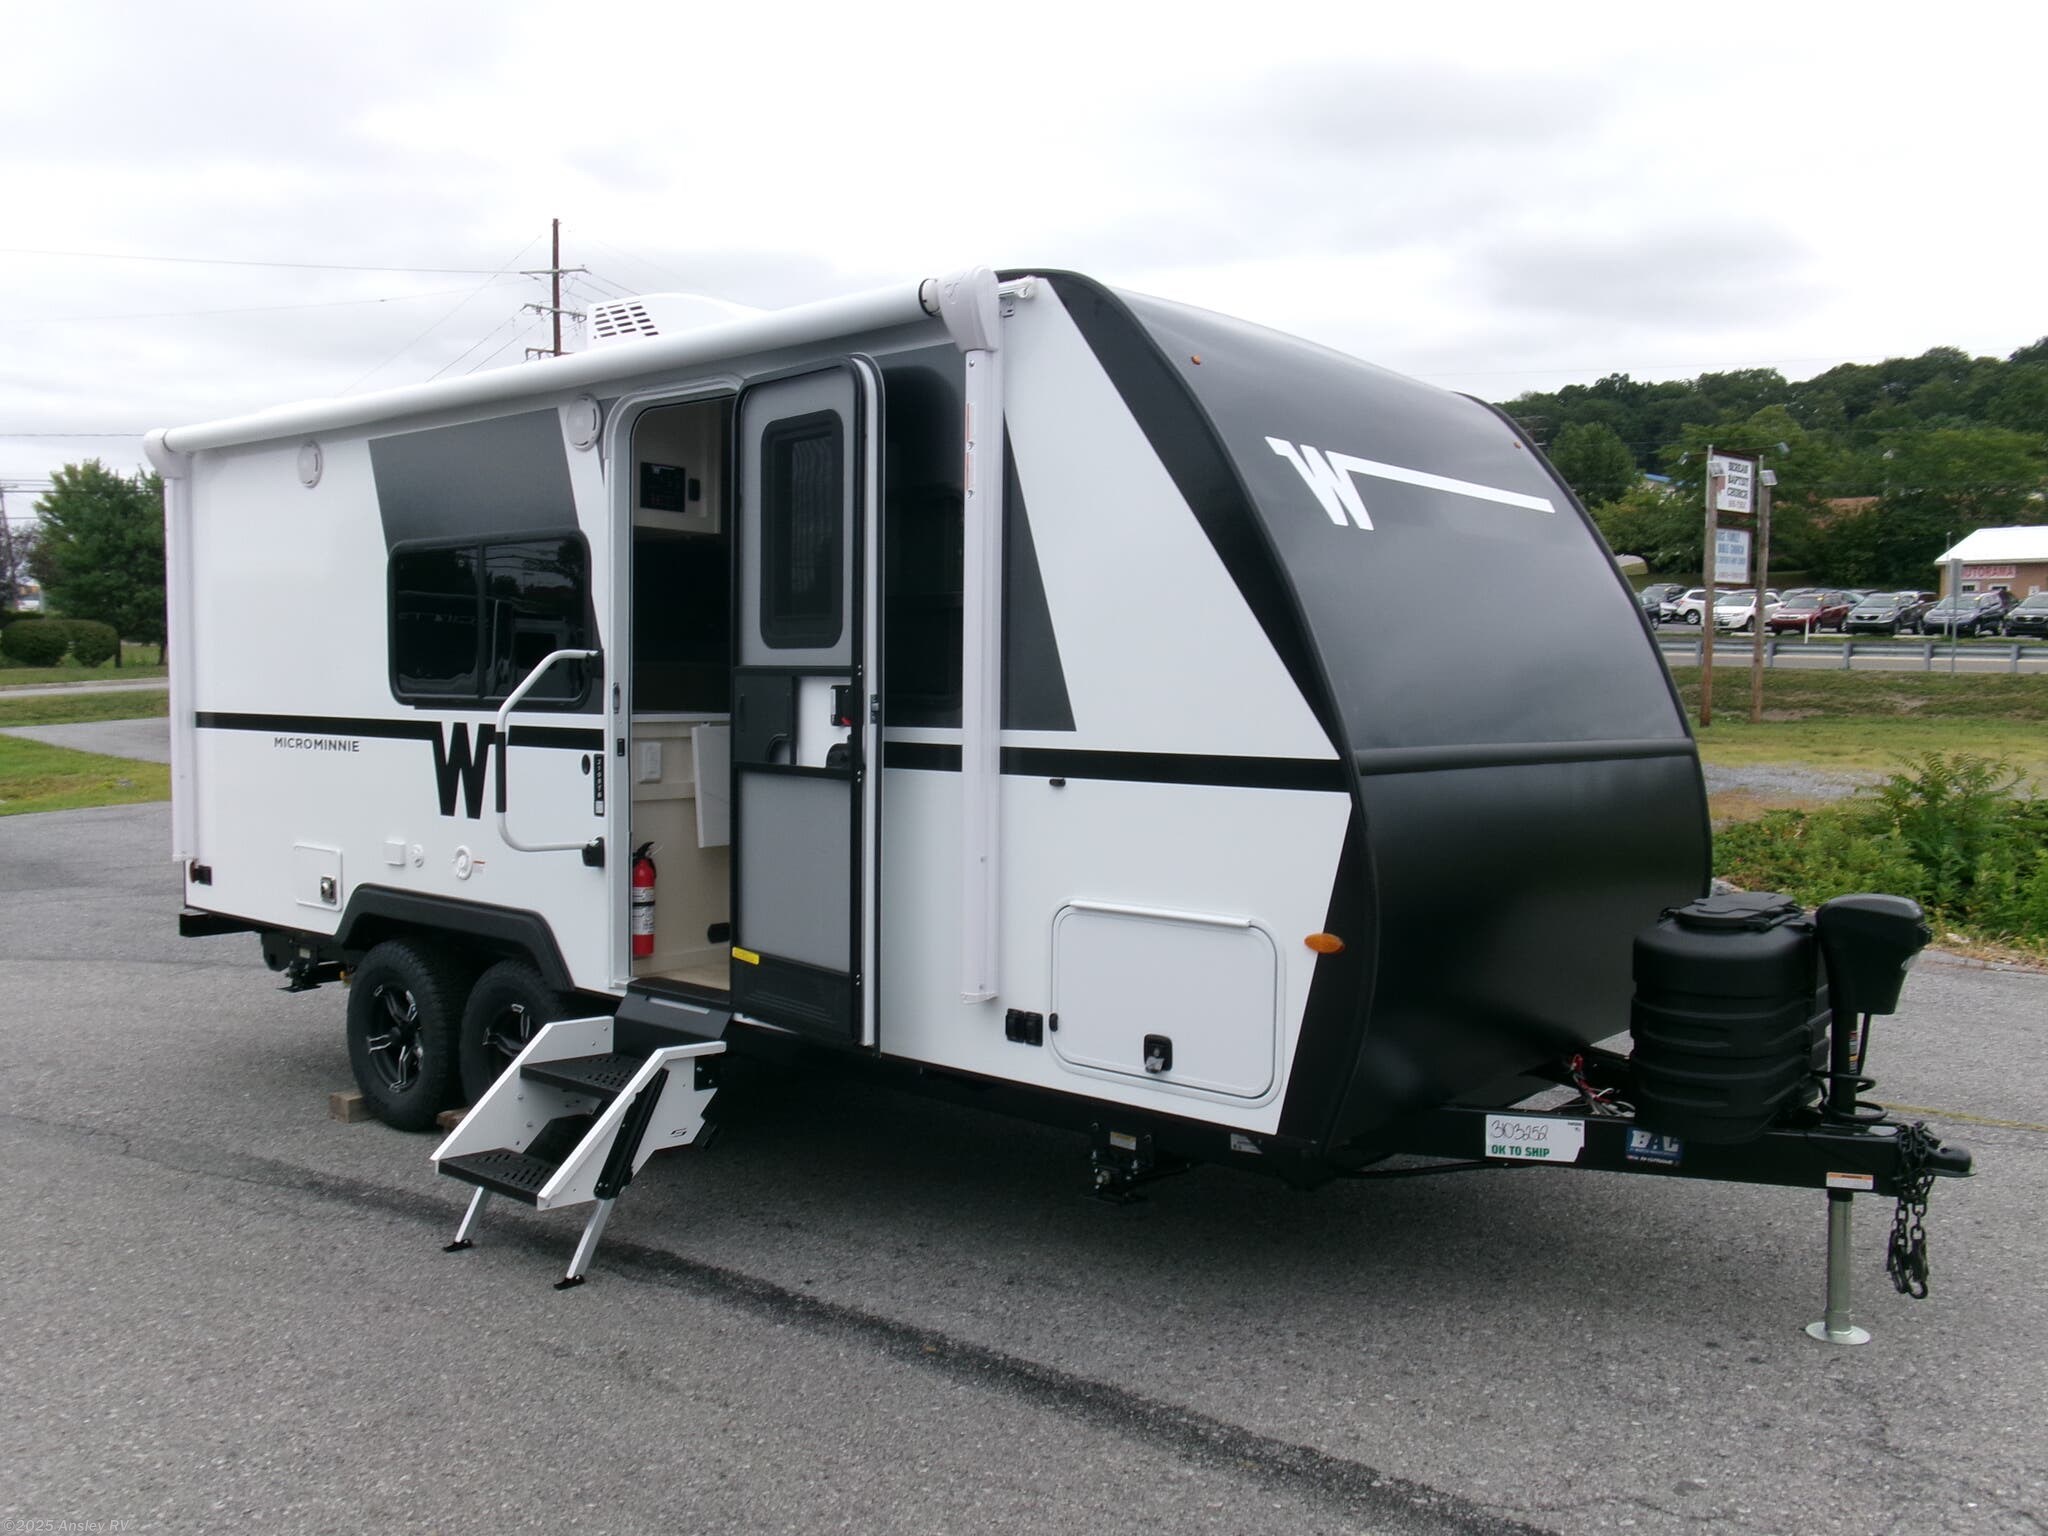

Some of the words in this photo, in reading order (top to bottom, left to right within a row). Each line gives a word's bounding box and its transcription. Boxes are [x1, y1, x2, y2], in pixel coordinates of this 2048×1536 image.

[1728, 475, 1749, 487] BAPTIST
[1727, 487, 1748, 499] CHURCH
[274, 737, 360, 752] MICROMINNIE
[1491, 1145, 1506, 1155] OK
[1509, 1146, 1522, 1156] TO
[1525, 1147, 1550, 1158] SHIP
